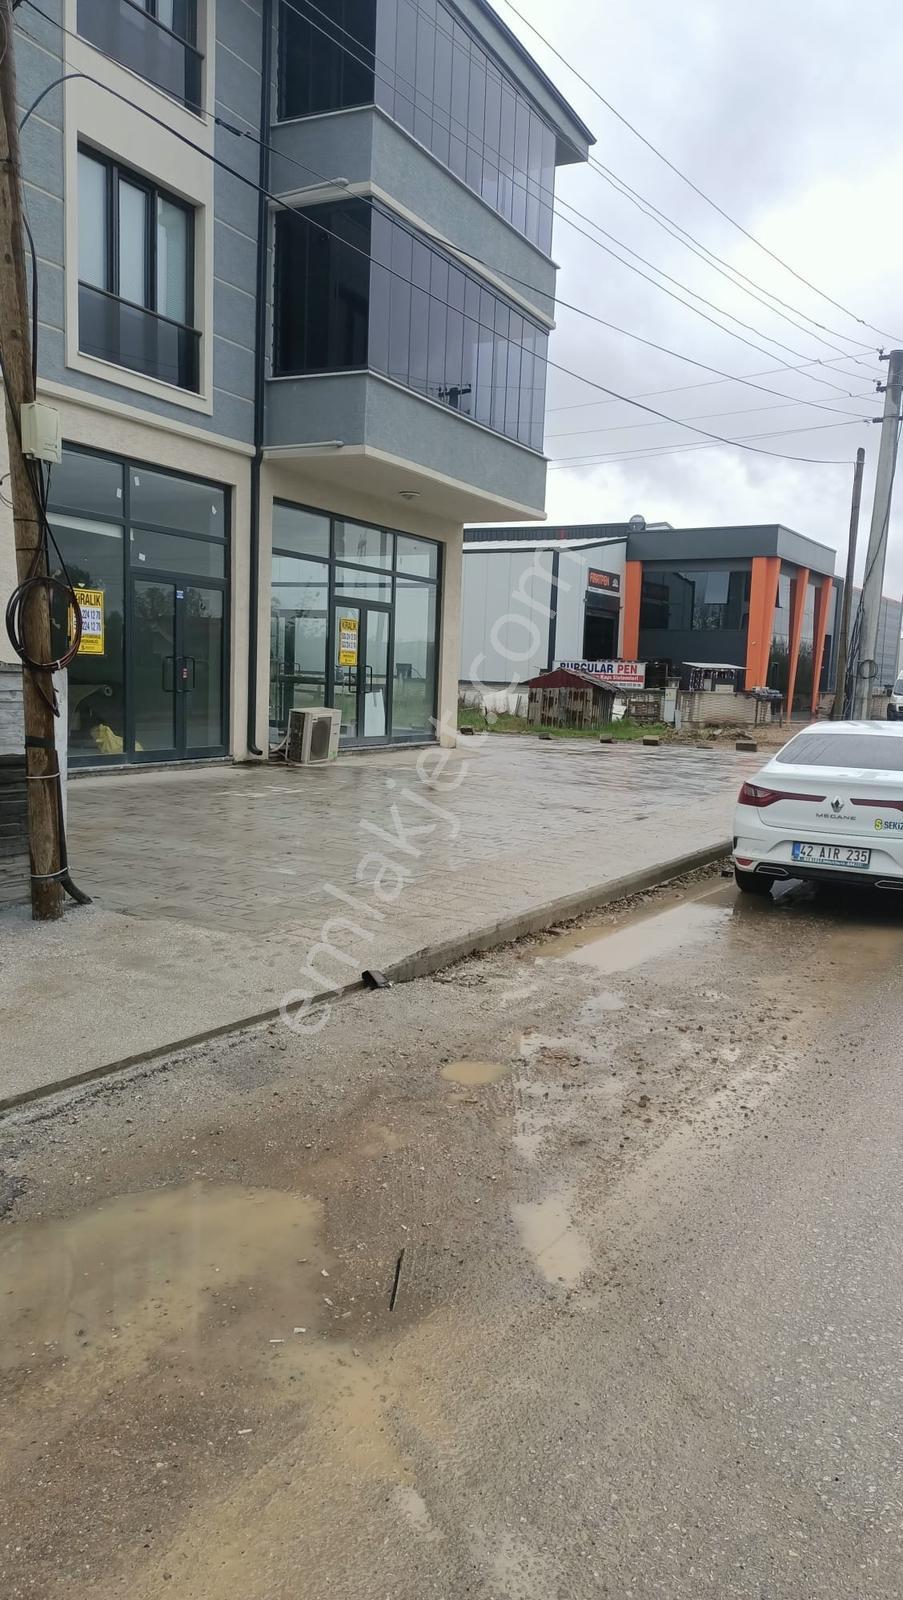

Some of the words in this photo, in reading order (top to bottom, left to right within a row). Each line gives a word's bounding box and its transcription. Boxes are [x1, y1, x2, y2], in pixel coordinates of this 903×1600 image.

[617, 664, 638, 674] PEN
[815, 813, 857, 821] MEGANE
[800, 845, 814, 857] 42
[819, 847, 841, 859] AIR
[846, 849, 868, 863] 235
